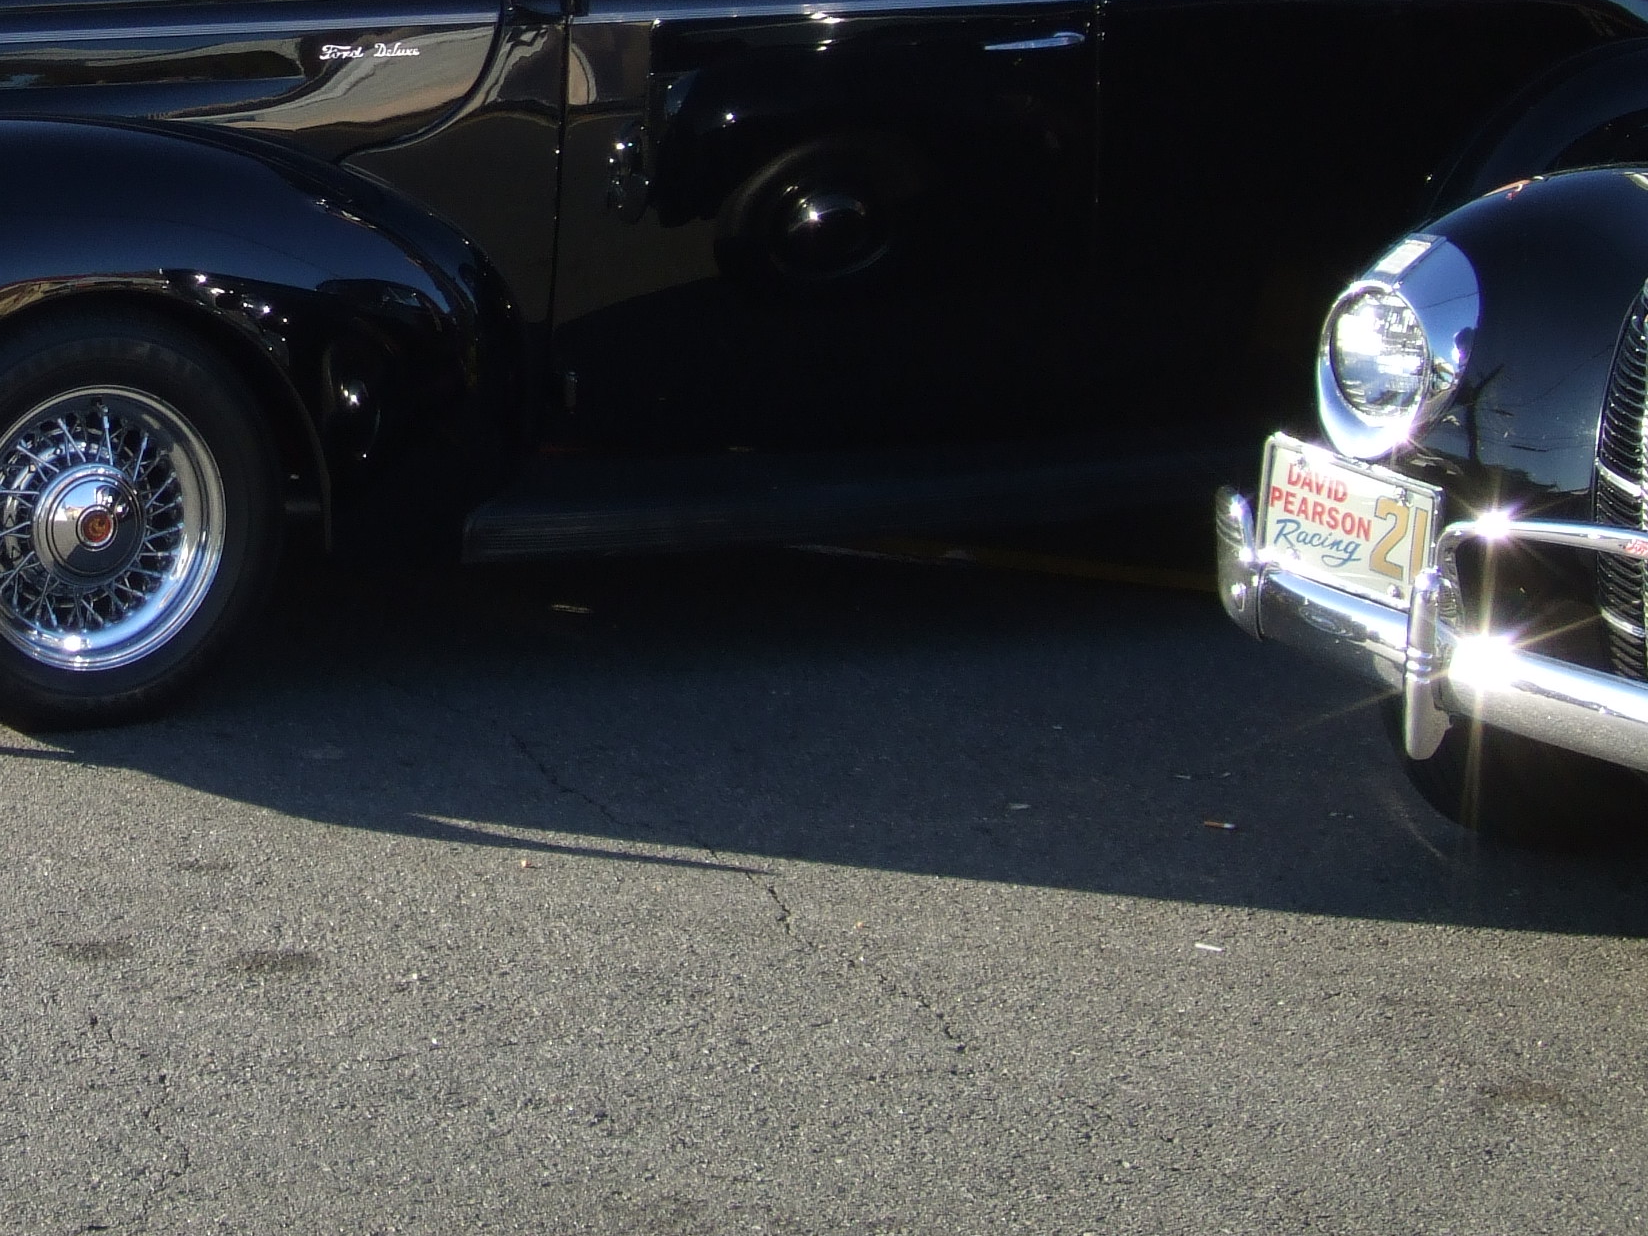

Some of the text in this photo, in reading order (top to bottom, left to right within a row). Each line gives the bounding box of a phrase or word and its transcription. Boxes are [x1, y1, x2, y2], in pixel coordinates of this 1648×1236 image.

[319, 43, 365, 61] Ford
[1286, 462, 1349, 504] DAVID
[1268, 485, 1373, 543] PEARSON
[1369, 494, 1429, 586] 21
[1273, 517, 1363, 569] Racing
